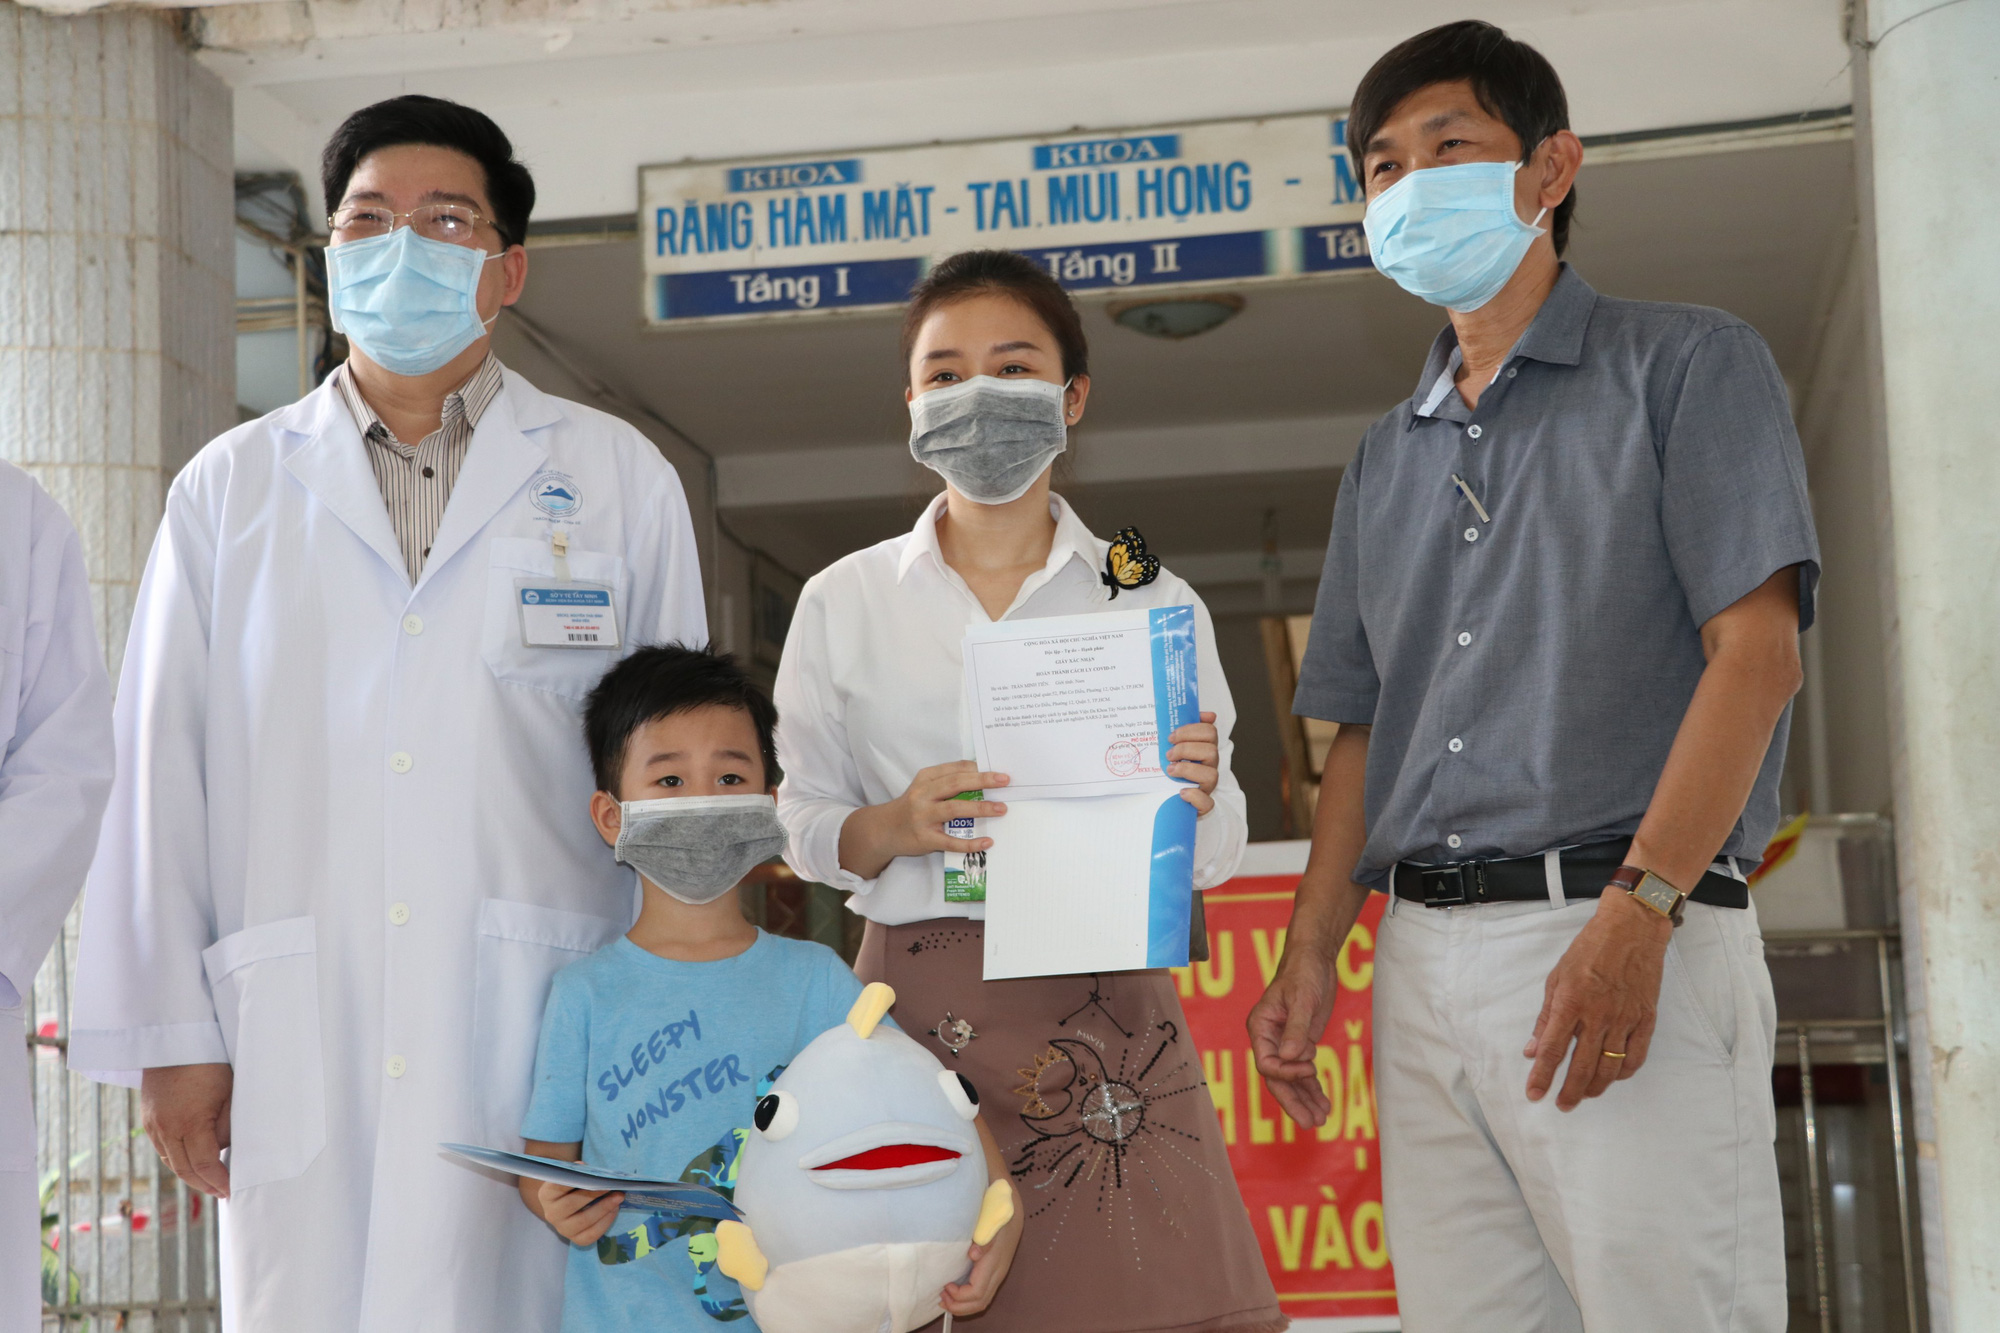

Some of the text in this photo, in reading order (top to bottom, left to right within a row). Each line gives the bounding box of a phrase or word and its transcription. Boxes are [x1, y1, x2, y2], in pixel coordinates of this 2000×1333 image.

[742, 163, 845, 190] KHOA
[1048, 140, 1161, 168] KHOA
[1137, 160, 1253, 223] HỌNG
[598, 1009, 702, 1102] SLEEPY
[621, 1054, 750, 1149] MONSTER
[1267, 1184, 1389, 1271] VÀO
